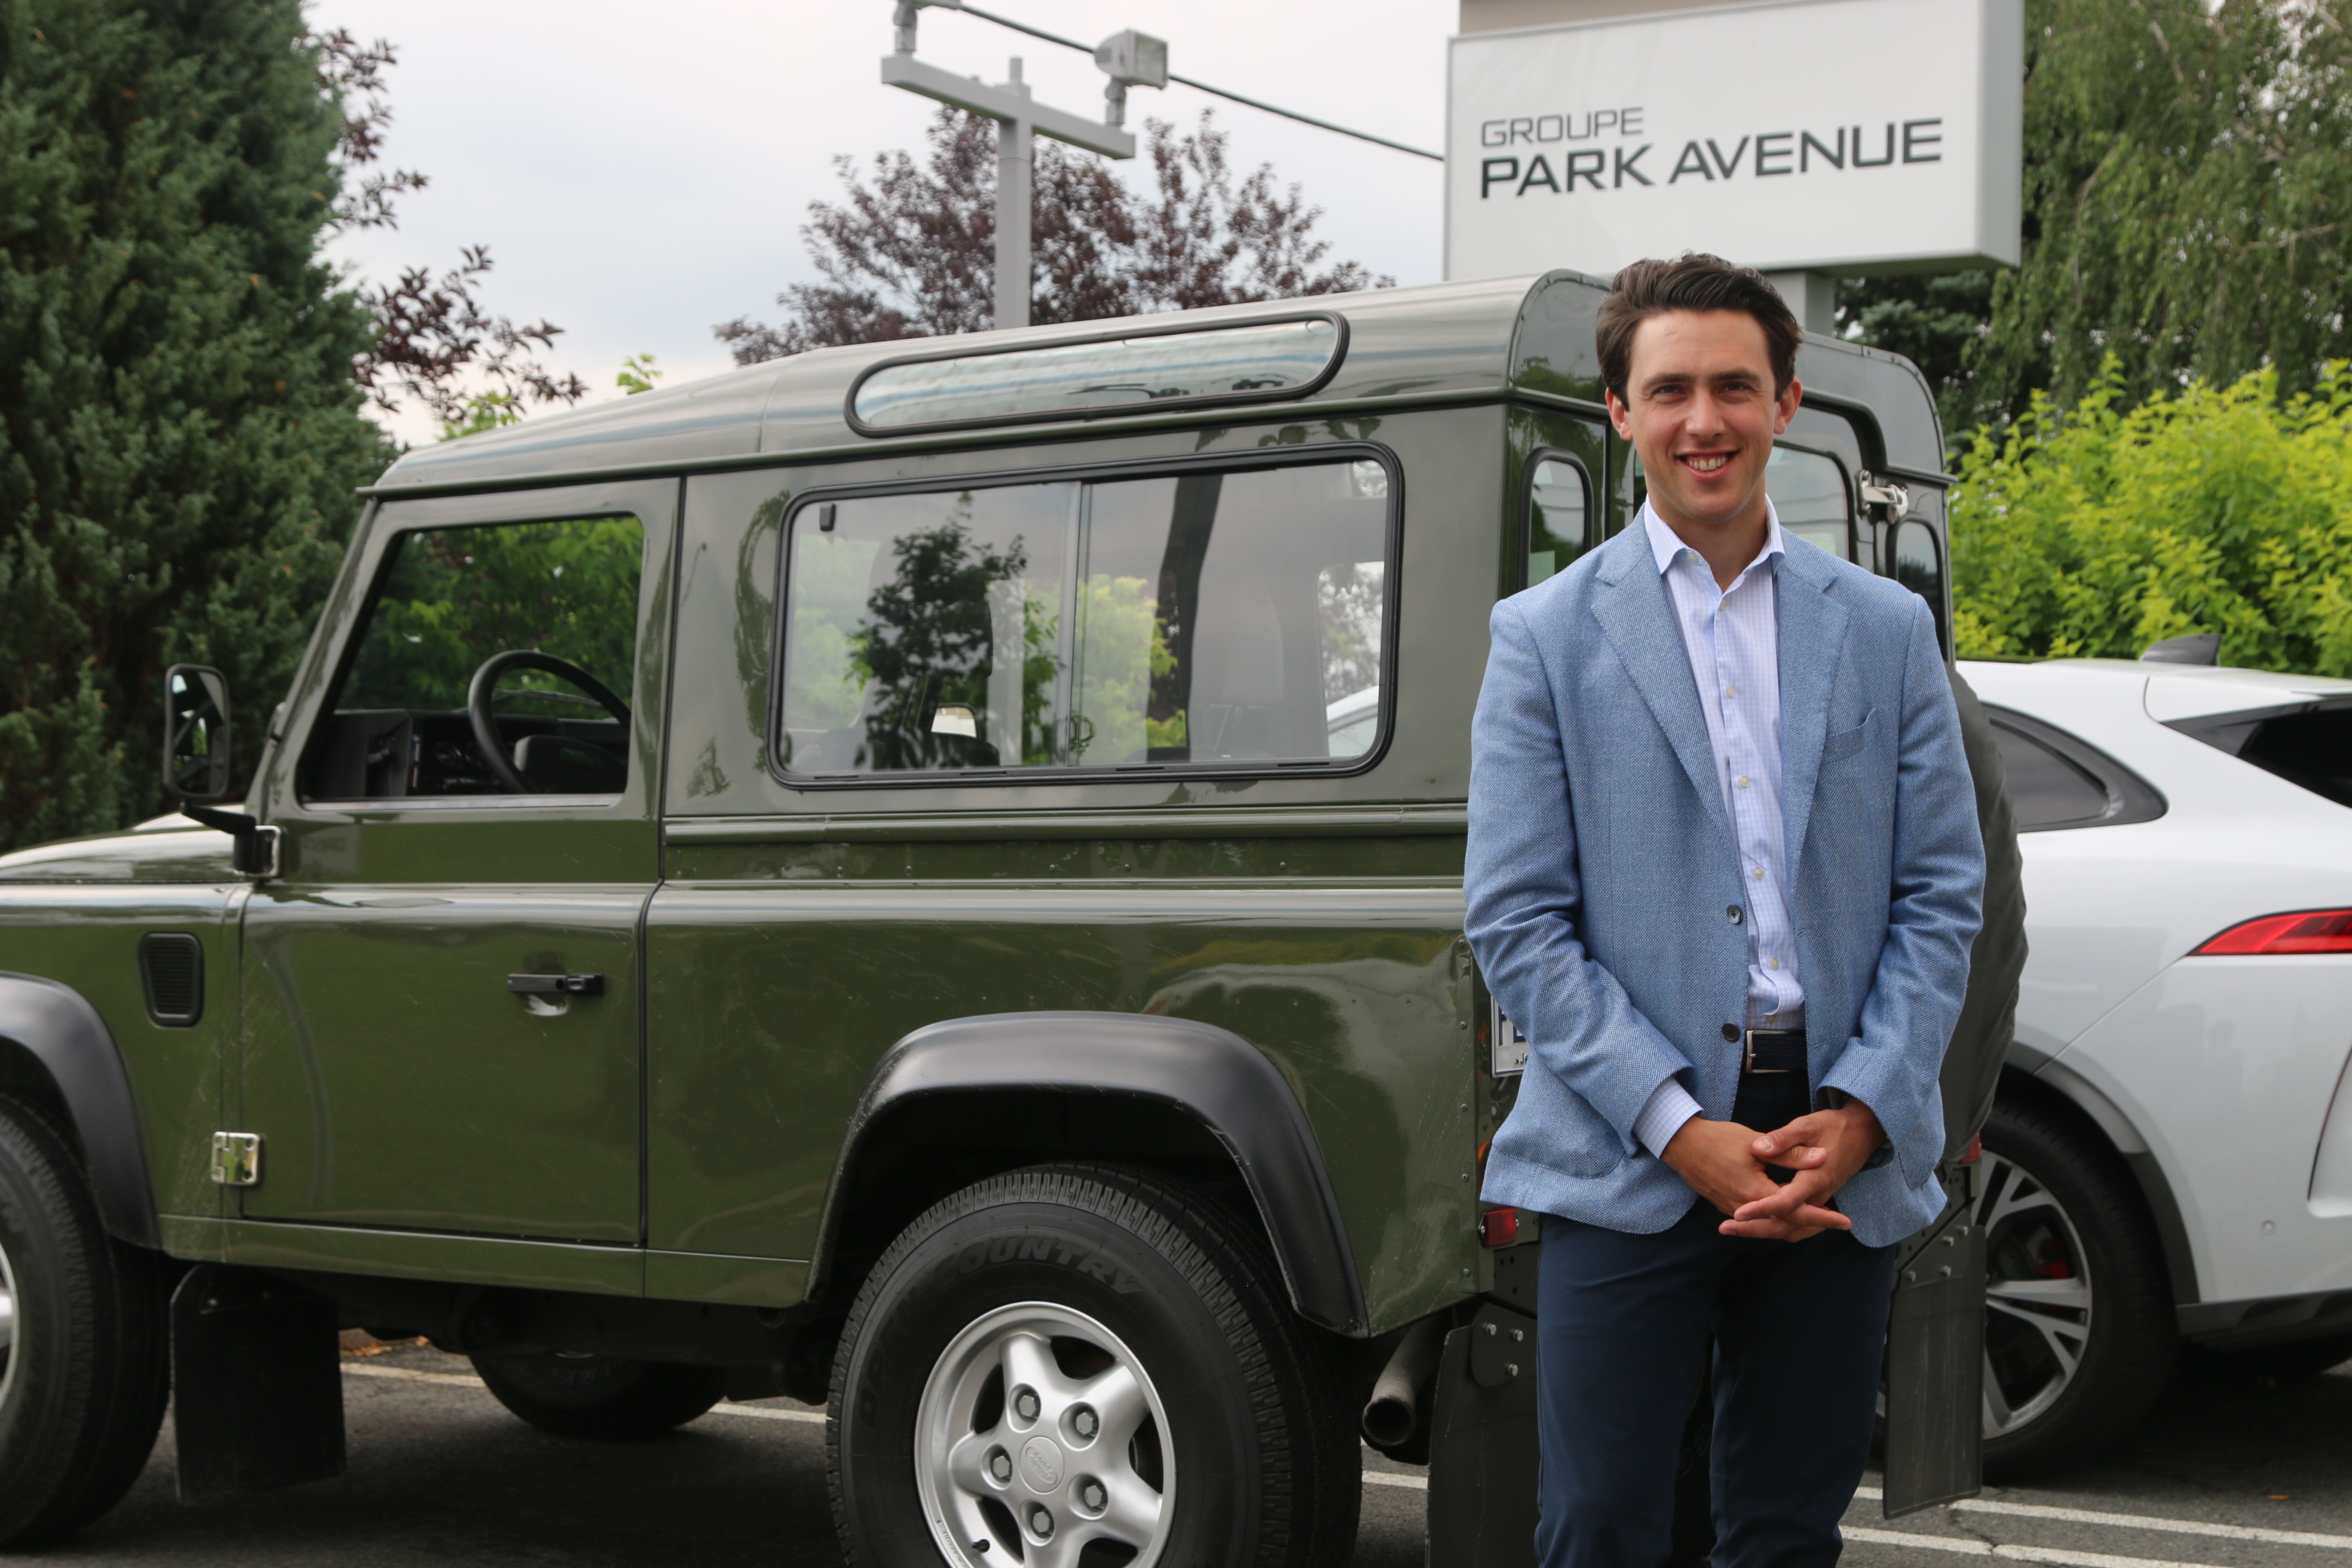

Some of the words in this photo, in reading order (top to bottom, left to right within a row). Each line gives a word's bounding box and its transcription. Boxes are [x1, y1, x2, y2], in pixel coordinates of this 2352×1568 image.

[1482, 106, 1644, 146] GROUPE
[1482, 143, 1656, 199] PARK
[1668, 117, 1943, 184] AVENUE
[934, 1237, 1146, 1294] COUNTRY
